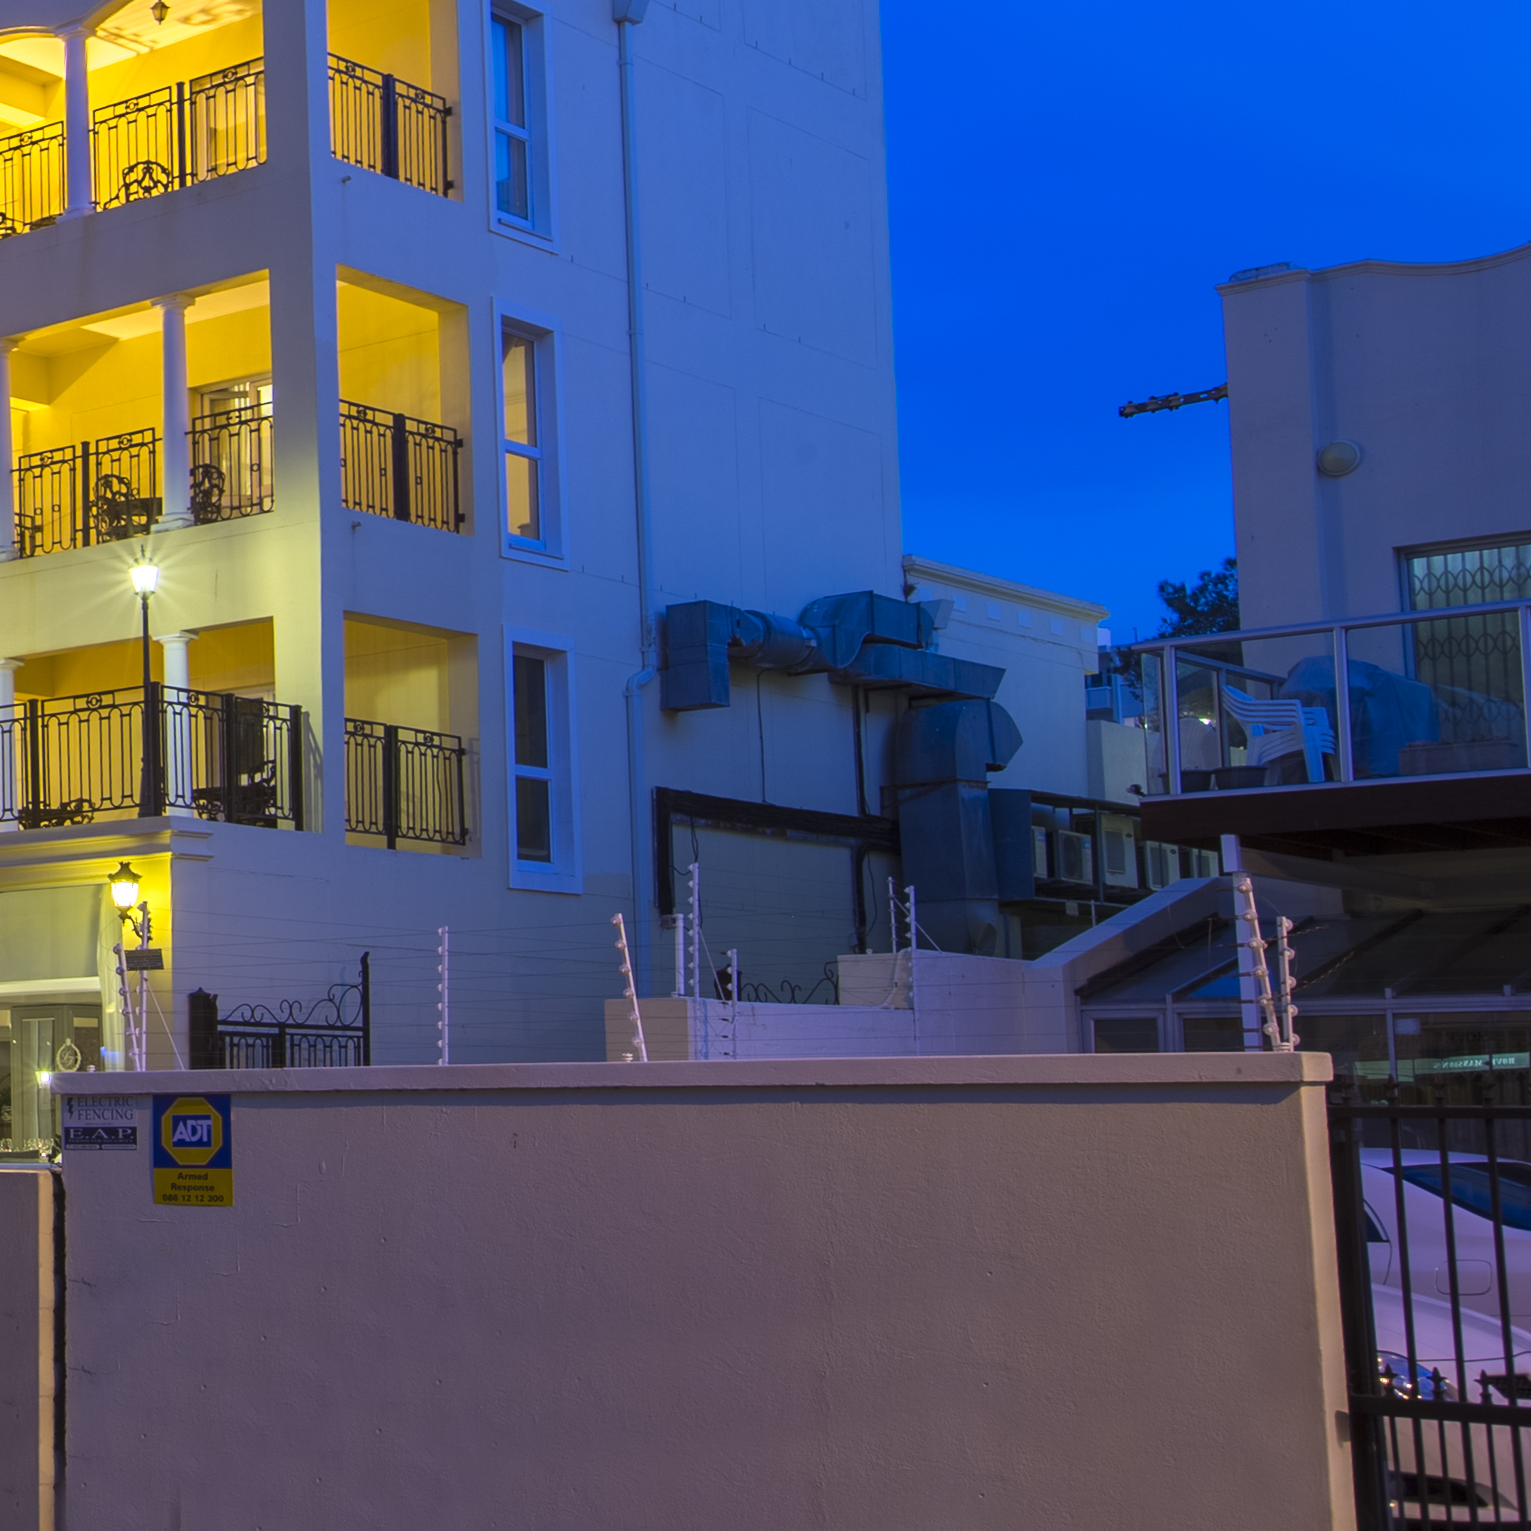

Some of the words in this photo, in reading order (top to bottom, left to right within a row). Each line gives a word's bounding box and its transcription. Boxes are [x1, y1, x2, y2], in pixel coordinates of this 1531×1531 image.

[77, 1096, 133, 1107] ELECTRIC
[77, 1109, 133, 1121] FENCING
[69, 1128, 134, 1139] E.A.P.
[172, 1119, 212, 1142] ADT
[177, 1172, 208, 1180] Armed
[171, 1183, 215, 1192] Response
